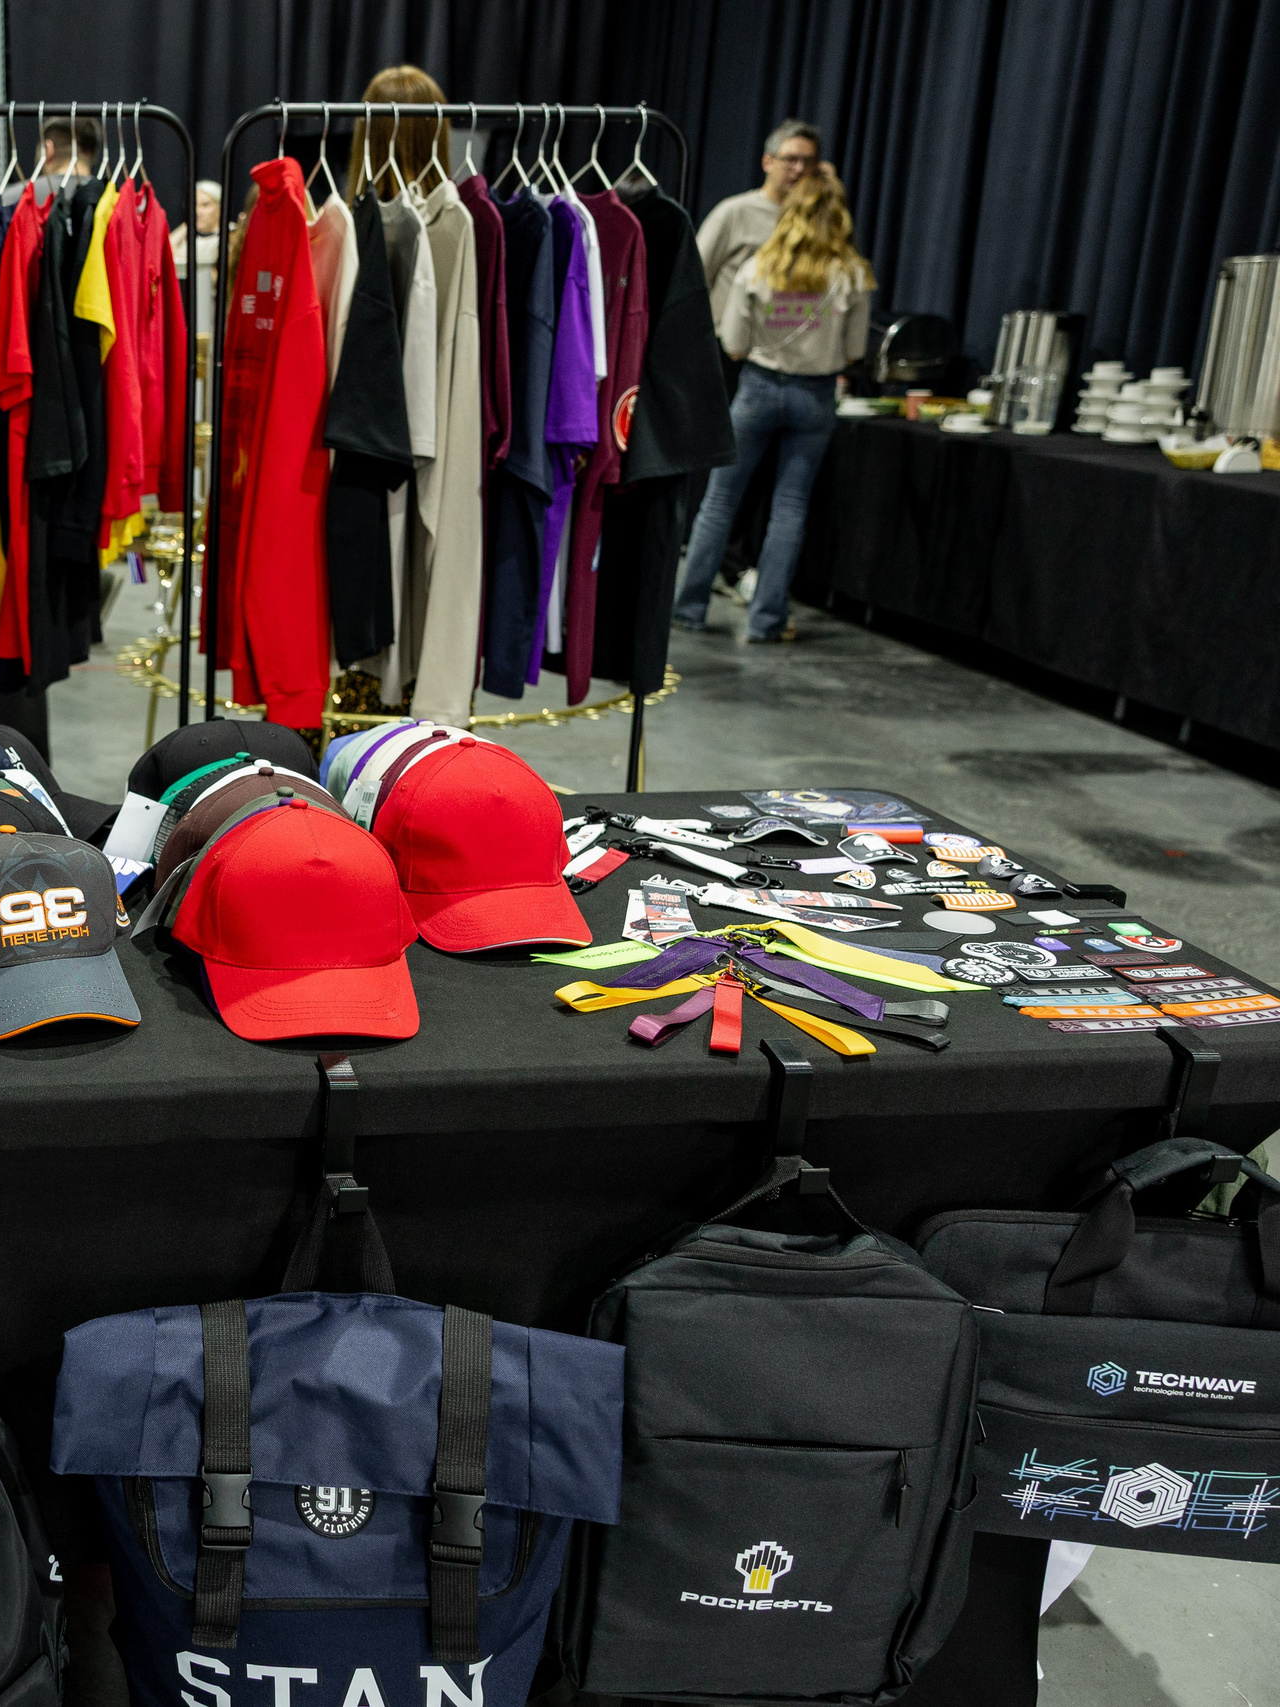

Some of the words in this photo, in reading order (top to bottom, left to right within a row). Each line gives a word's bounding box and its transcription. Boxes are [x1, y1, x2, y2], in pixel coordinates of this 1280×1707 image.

[1, 926, 90, 948] ПЕНЕТРОН
[1048, 987, 1110, 995] STAN
[1172, 981, 1229, 991] STAN
[1191, 989, 1248, 1000] STAN
[1207, 999, 1266, 1011] STAN
[1226, 1010, 1280, 1022] STAN
[1099, 1019, 1163, 1028] STAN
[1136, 1371, 1257, 1394] TECHWAVE
[1133, 1386, 1184, 1397] technologies
[1196, 1391, 1209, 1399] the
[316, 1486, 355, 1515] 91
[301, 1501, 322, 1528] STAN
[323, 1505, 370, 1534] CLOTHING
[680, 1591, 833, 1613] РОСНЕФТЬ
[176, 1650, 493, 1707] STAN
